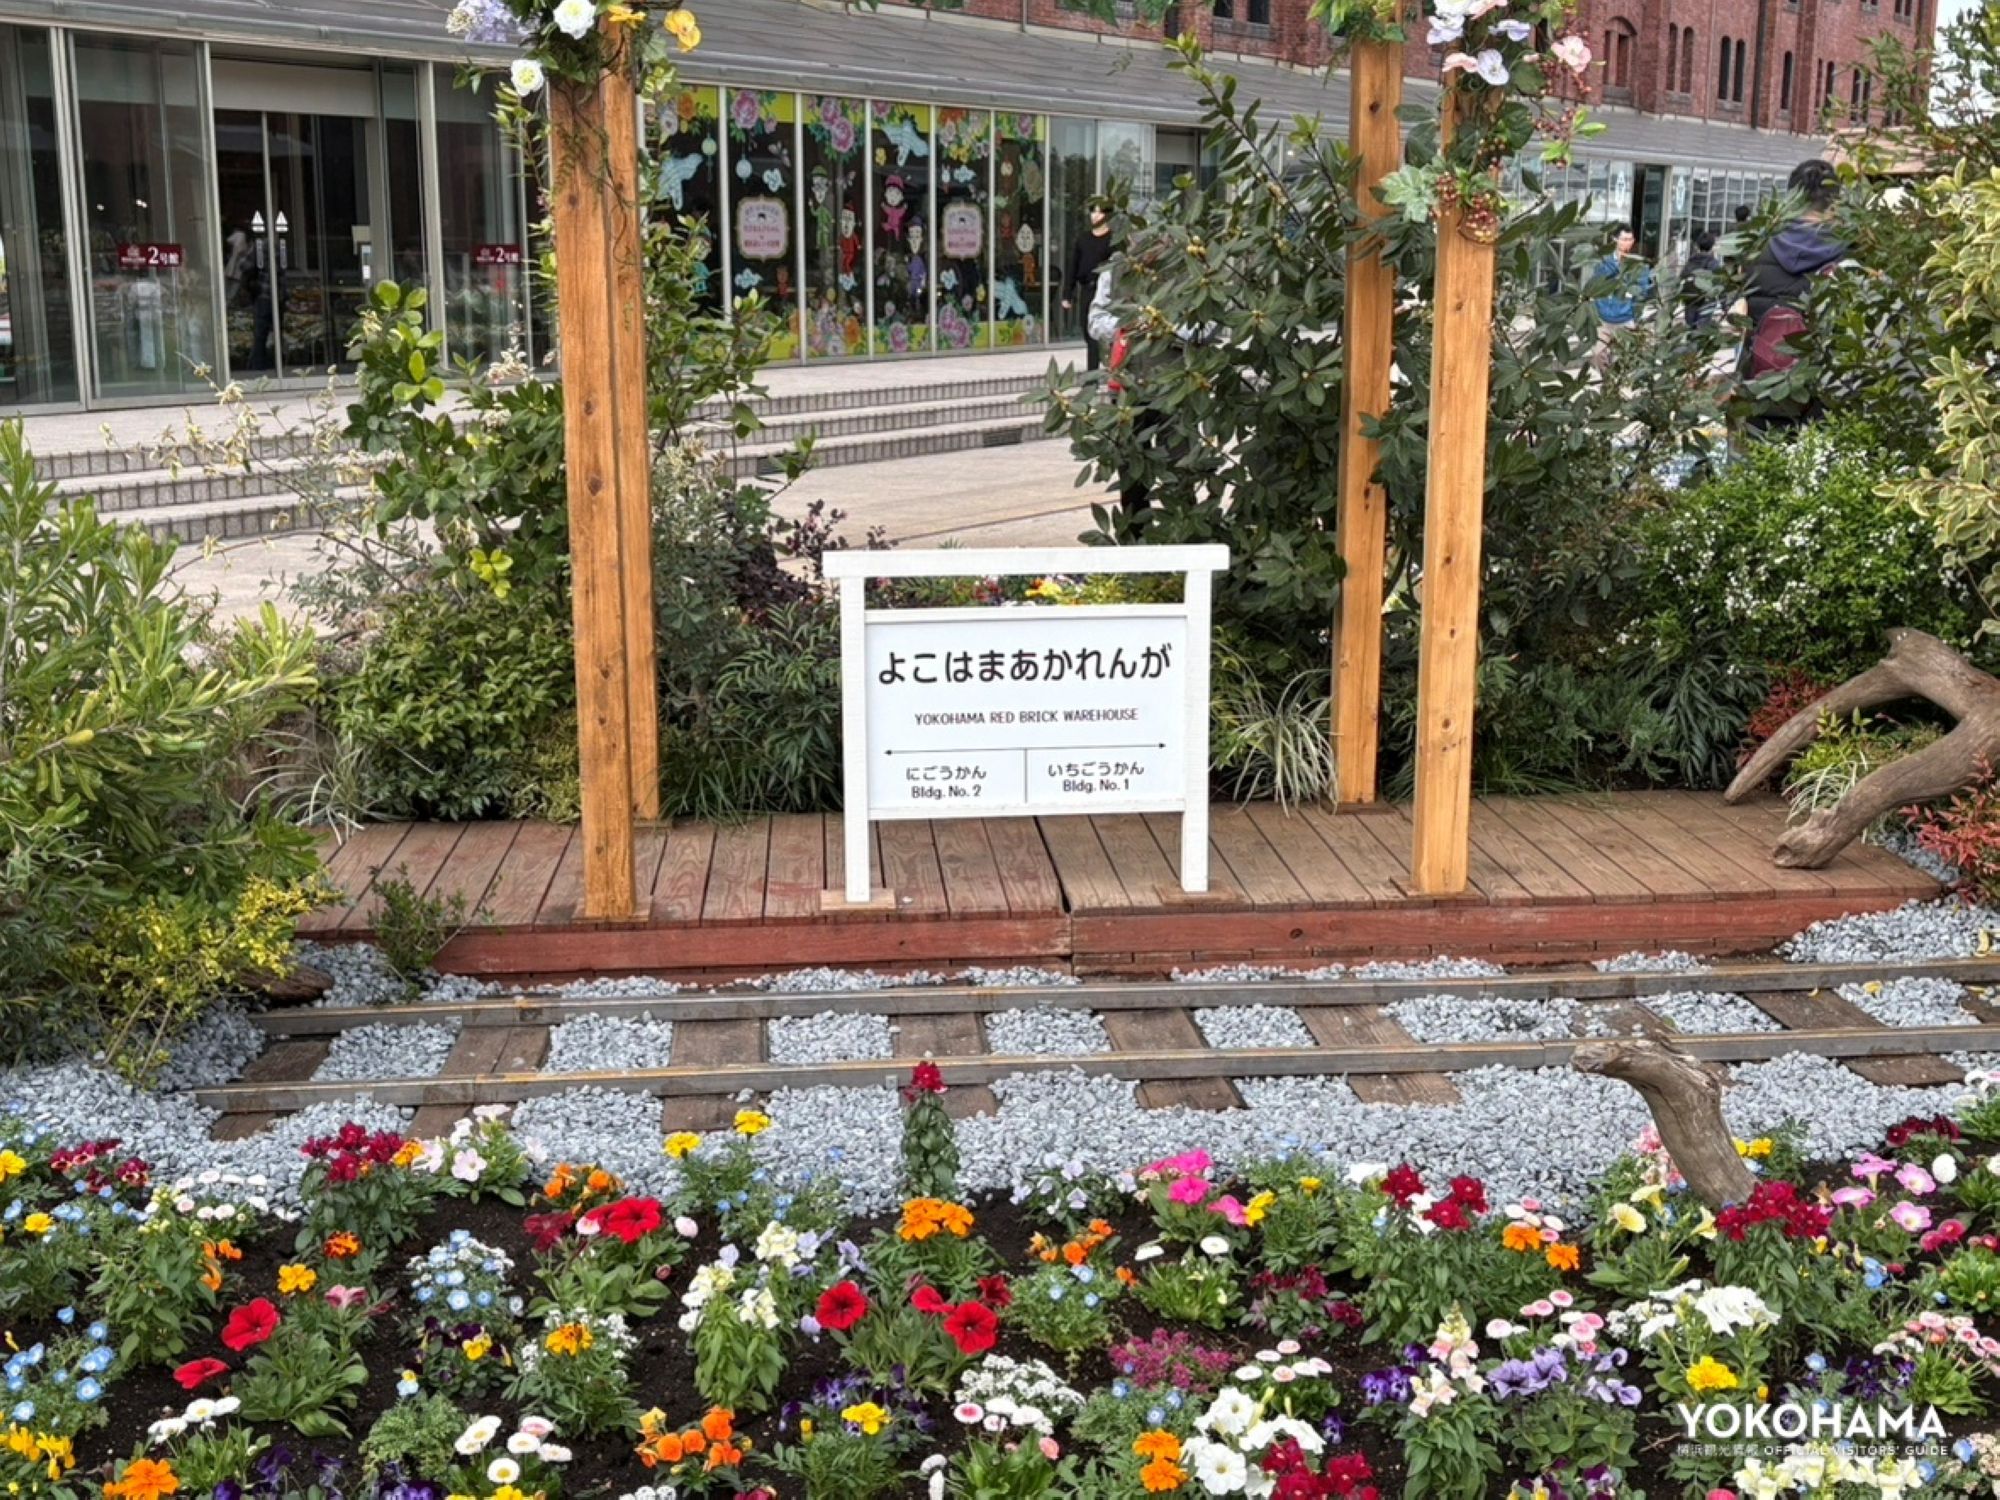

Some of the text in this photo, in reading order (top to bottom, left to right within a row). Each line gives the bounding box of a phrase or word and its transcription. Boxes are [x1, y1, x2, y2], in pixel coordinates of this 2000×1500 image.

[878, 642, 1172, 685] よこはまあかれんが
[914, 708, 1138, 726] YOKOHAMA RED BRICK WAREHOUSE
[906, 765, 987, 780] にごうかん
[1048, 761, 1144, 777] いちごうかん
